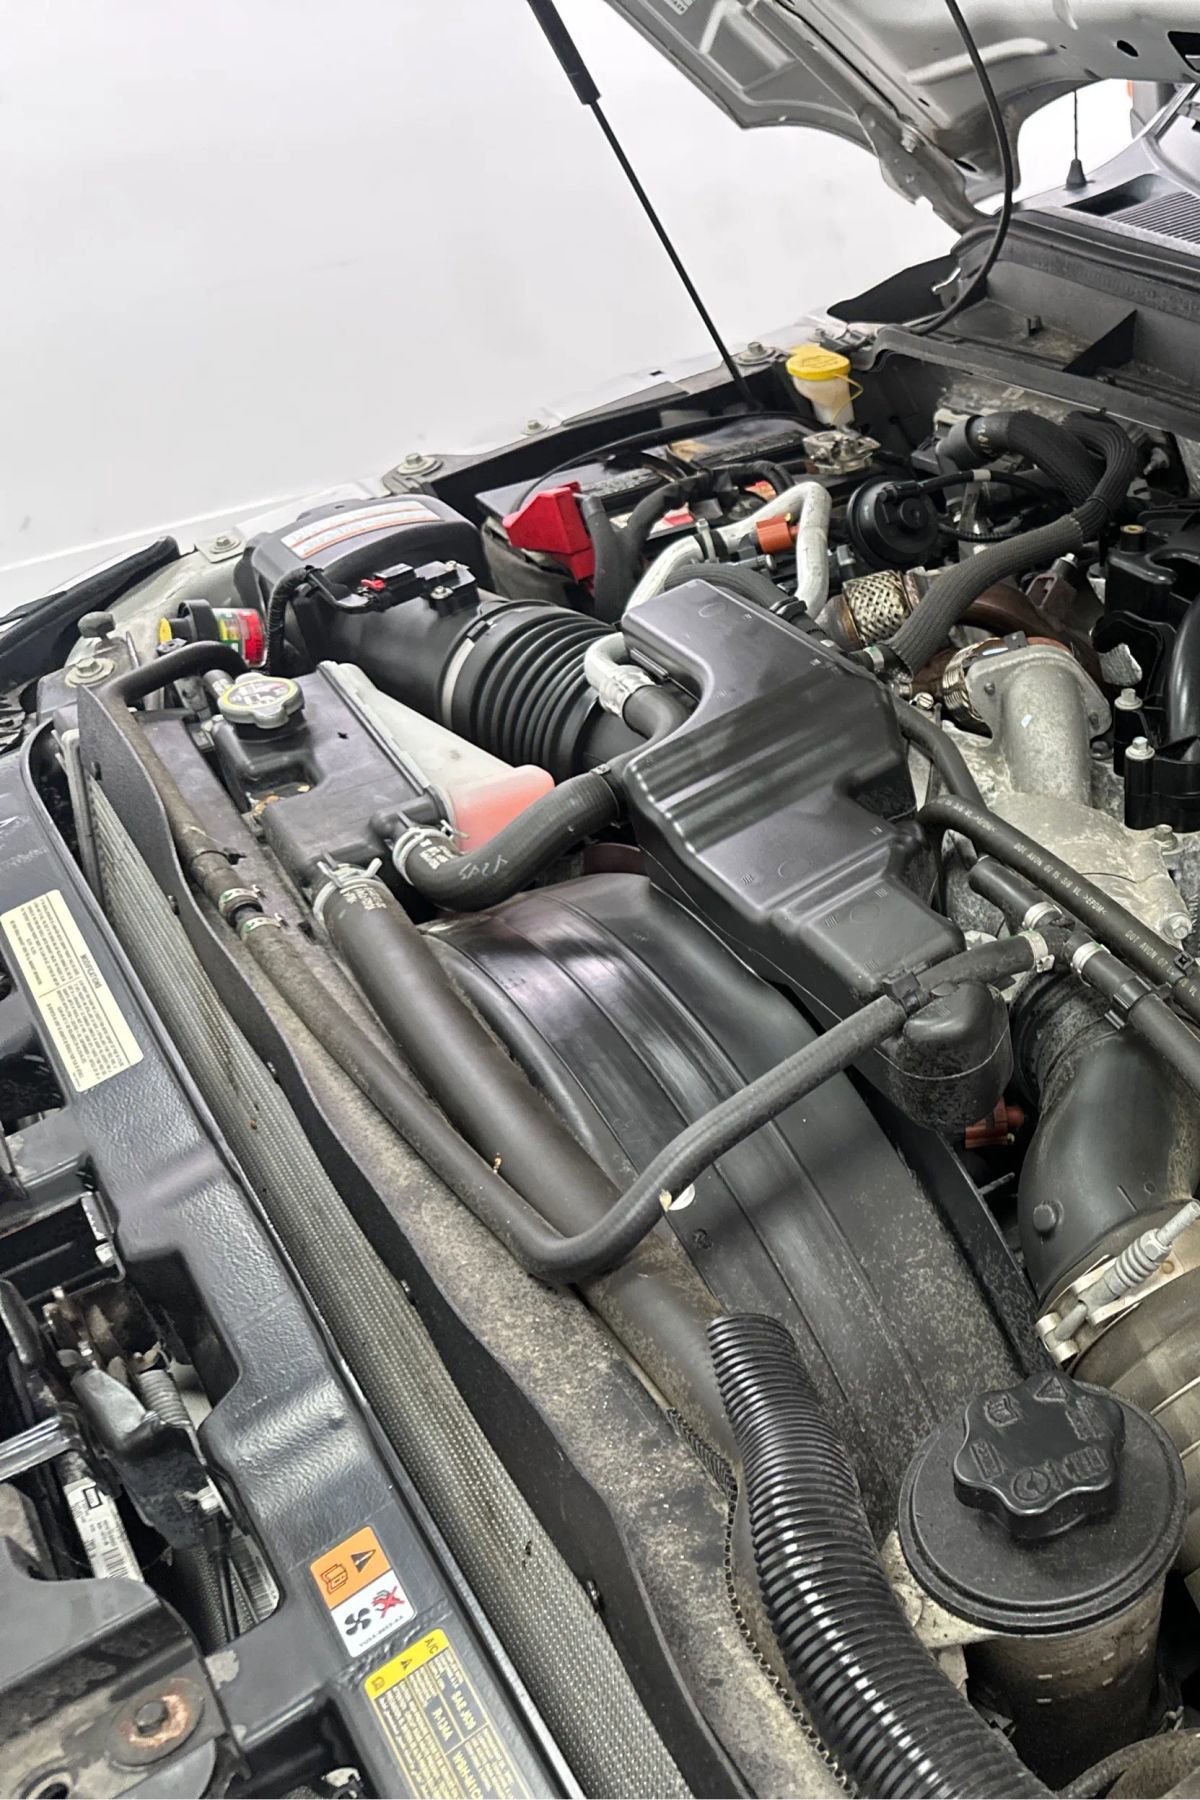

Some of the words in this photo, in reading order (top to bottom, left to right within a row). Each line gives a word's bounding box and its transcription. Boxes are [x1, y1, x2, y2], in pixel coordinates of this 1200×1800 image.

[1025, 852, 1044, 868] AVON
[1124, 929, 1140, 944] DOT
[1138, 941, 1159, 960] AVON
[428, 1707, 458, 1742] R-134A
